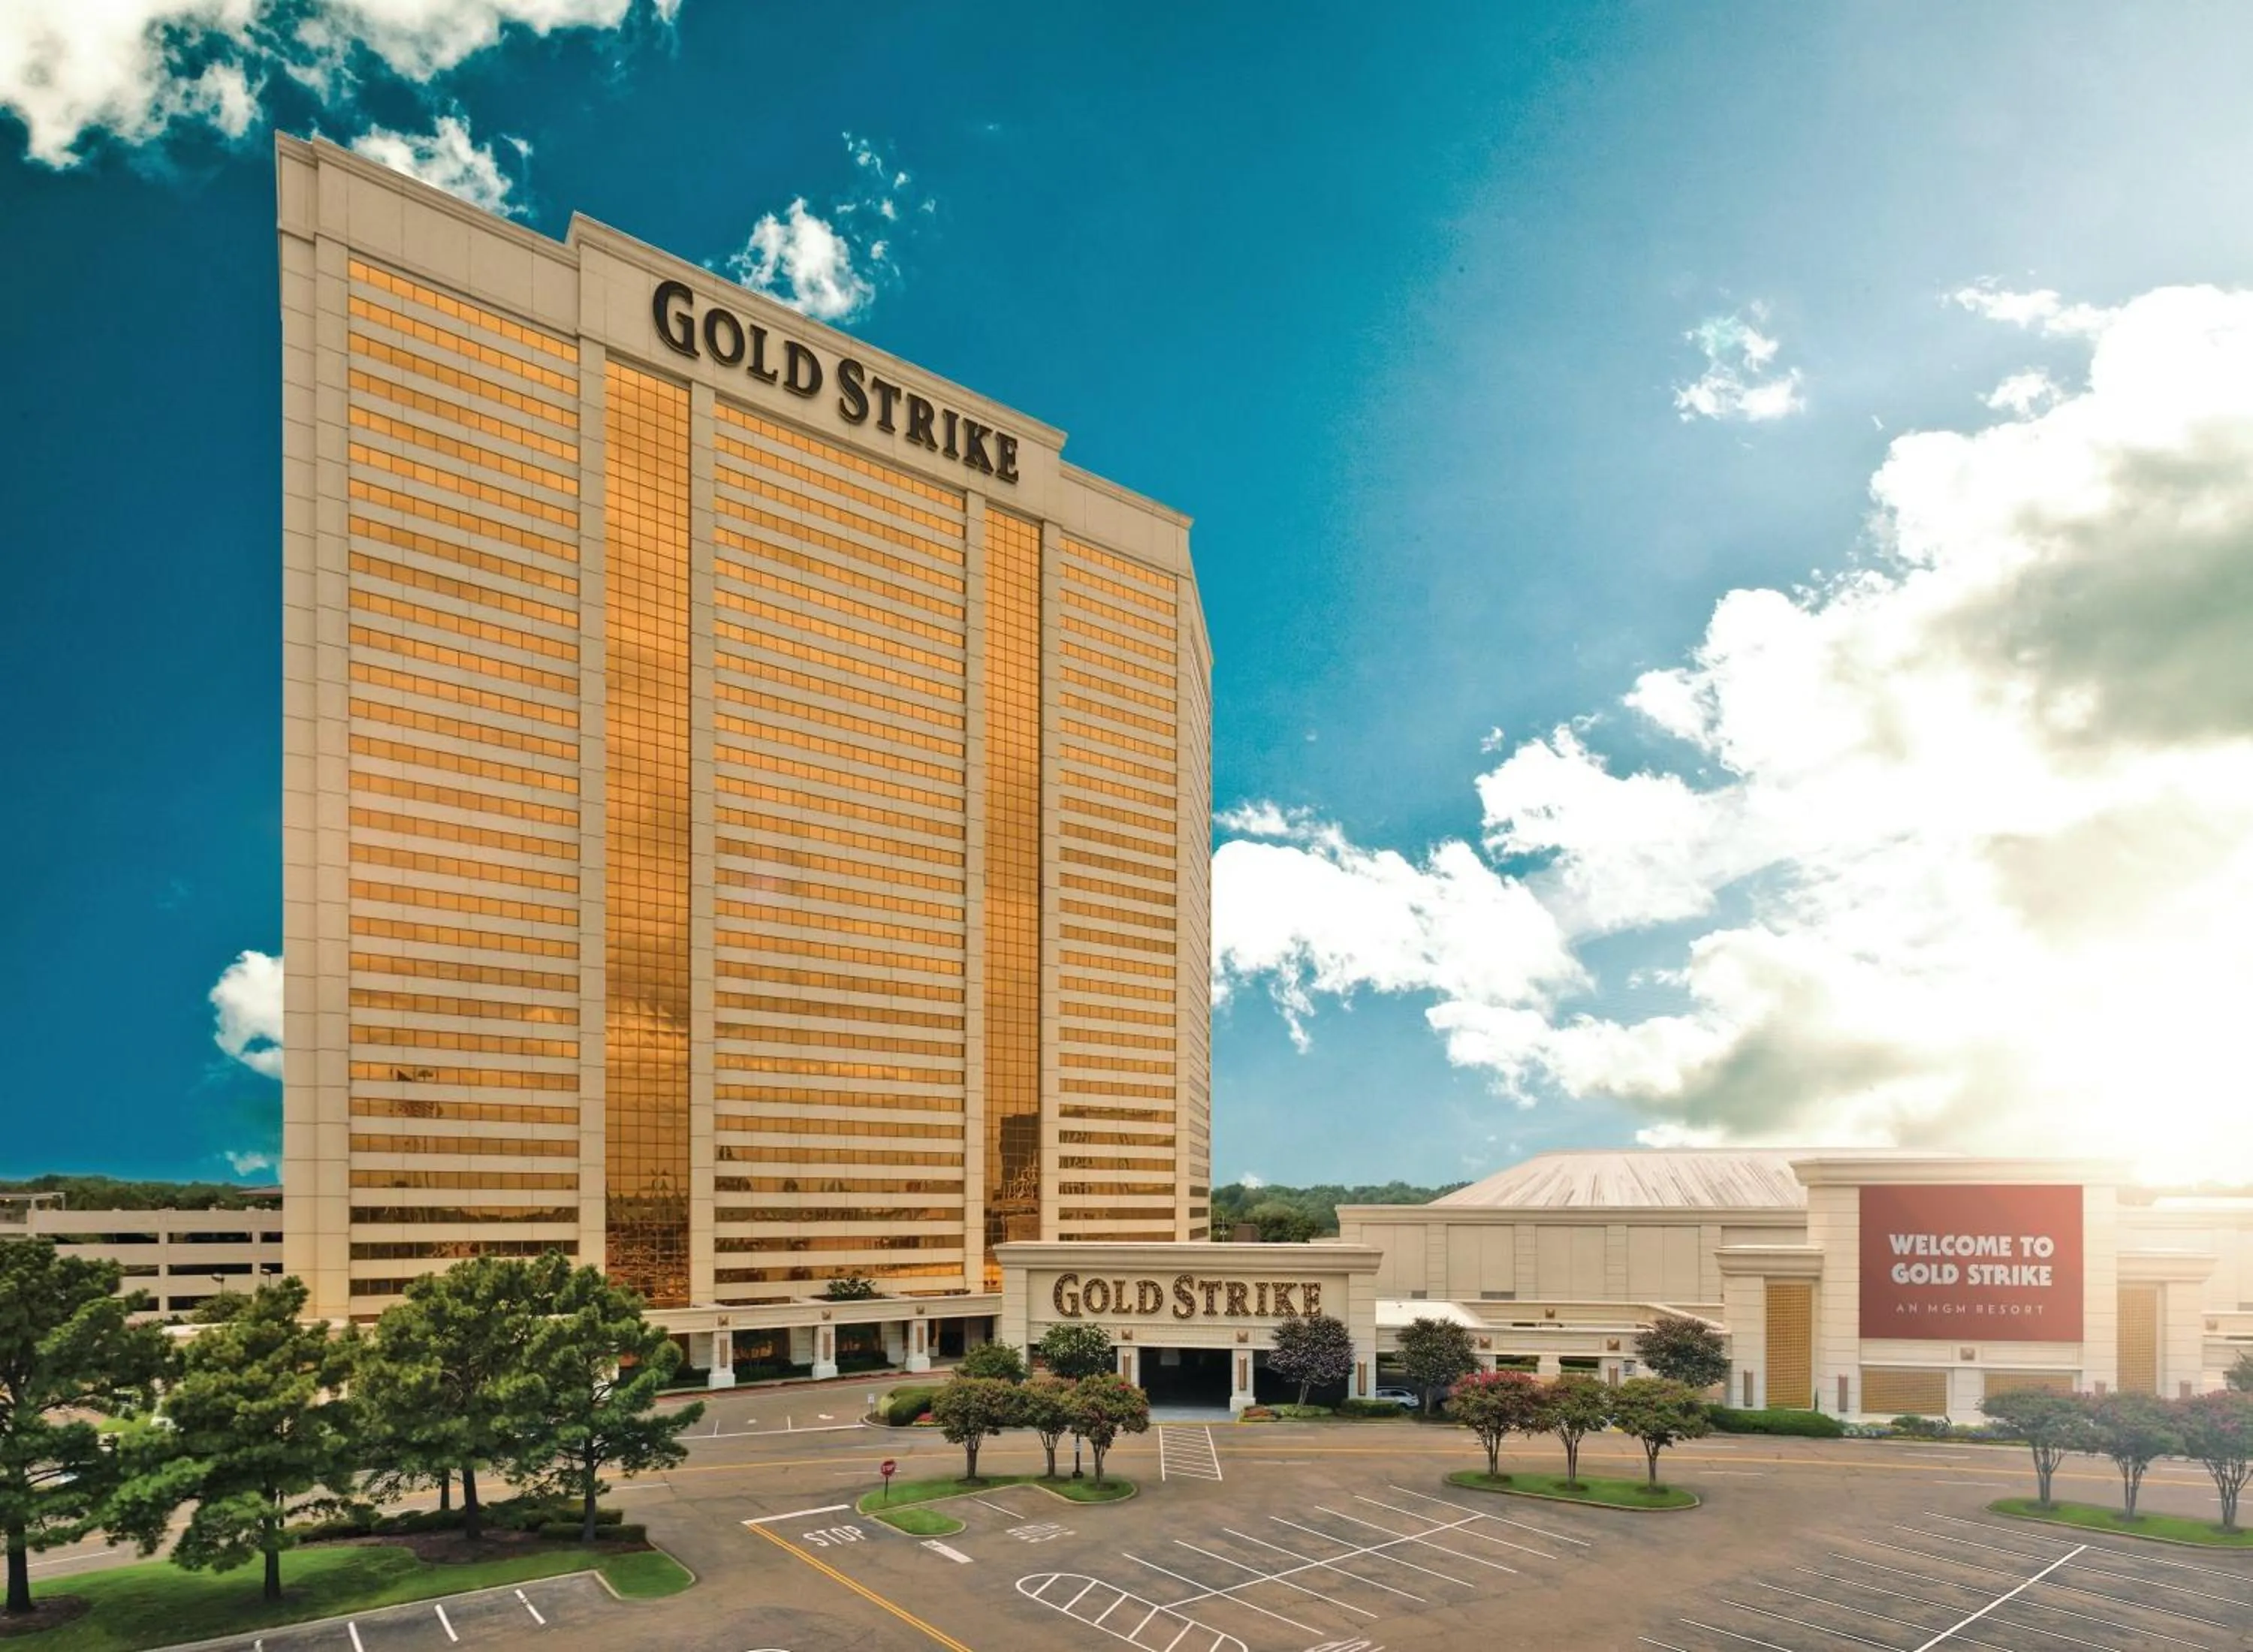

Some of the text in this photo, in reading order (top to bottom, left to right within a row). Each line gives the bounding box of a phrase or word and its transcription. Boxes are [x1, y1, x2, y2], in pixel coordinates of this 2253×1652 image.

[652, 279, 1019, 484] GOLD STRIKE
[1889, 1234, 2055, 1258] WELCOME TO
[1891, 1262, 2052, 1286] GOLD STRIKE
[1053, 1273, 1322, 1319] GOLD STRIKE
[1896, 1304, 2043, 1316] AN MGM RESORT
[802, 1525, 866, 1547] STOP
